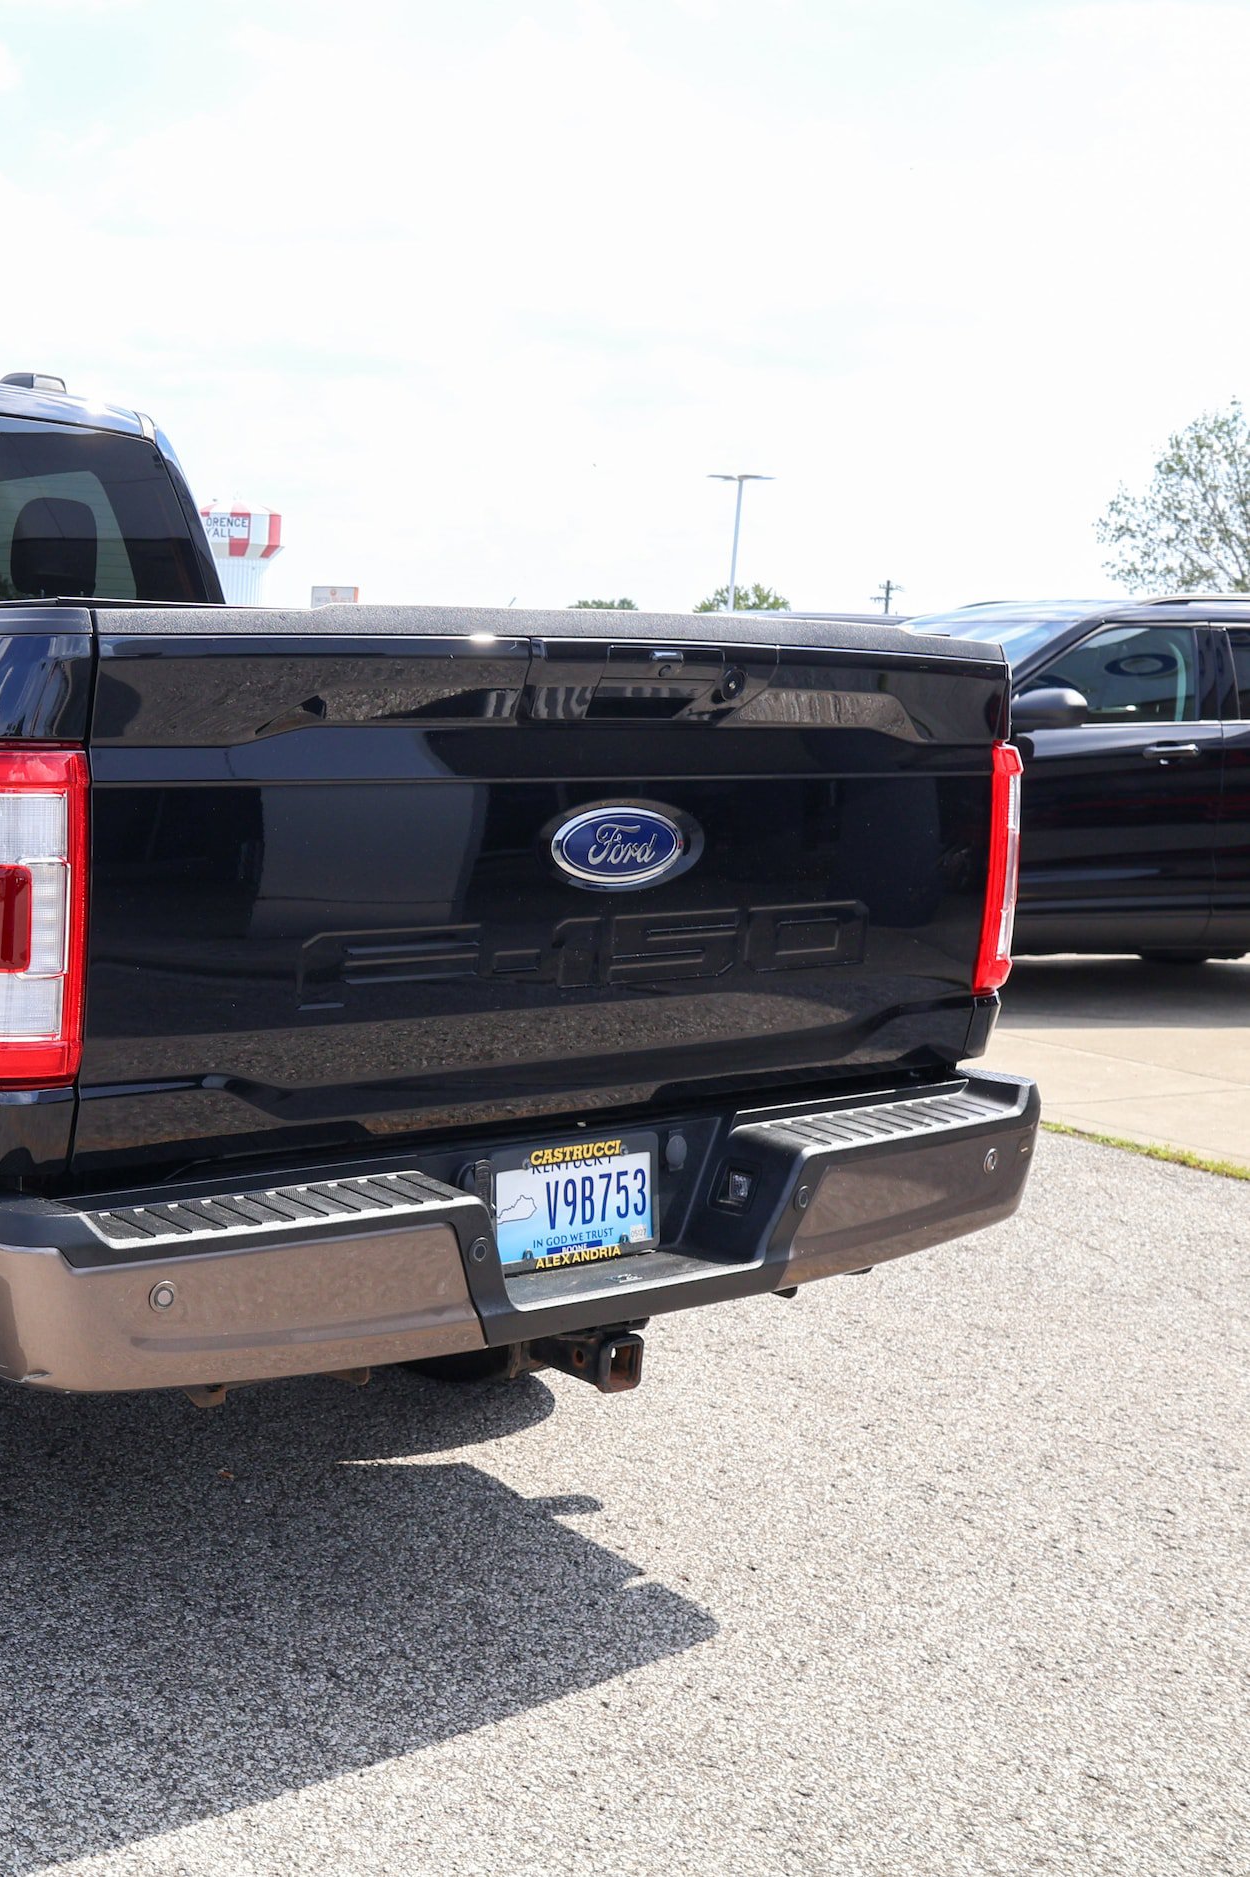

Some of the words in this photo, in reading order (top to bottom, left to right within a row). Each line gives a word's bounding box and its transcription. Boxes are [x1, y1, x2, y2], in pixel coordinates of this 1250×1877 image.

[205, 517, 248, 527] ORENCE
[588, 823, 658, 866] Ford
[298, 900, 868, 1011] F-150
[530, 1139, 621, 1166] CASTRUCCI
[546, 1168, 646, 1230] V9B753
[533, 1239, 543, 1249] IN
[546, 1235, 568, 1247] GOD
[570, 1232, 584, 1242] WE
[586, 1227, 614, 1240] TRUST
[561, 1243, 588, 1253] BOONE
[536, 1244, 622, 1270] ALEXANDRIA
